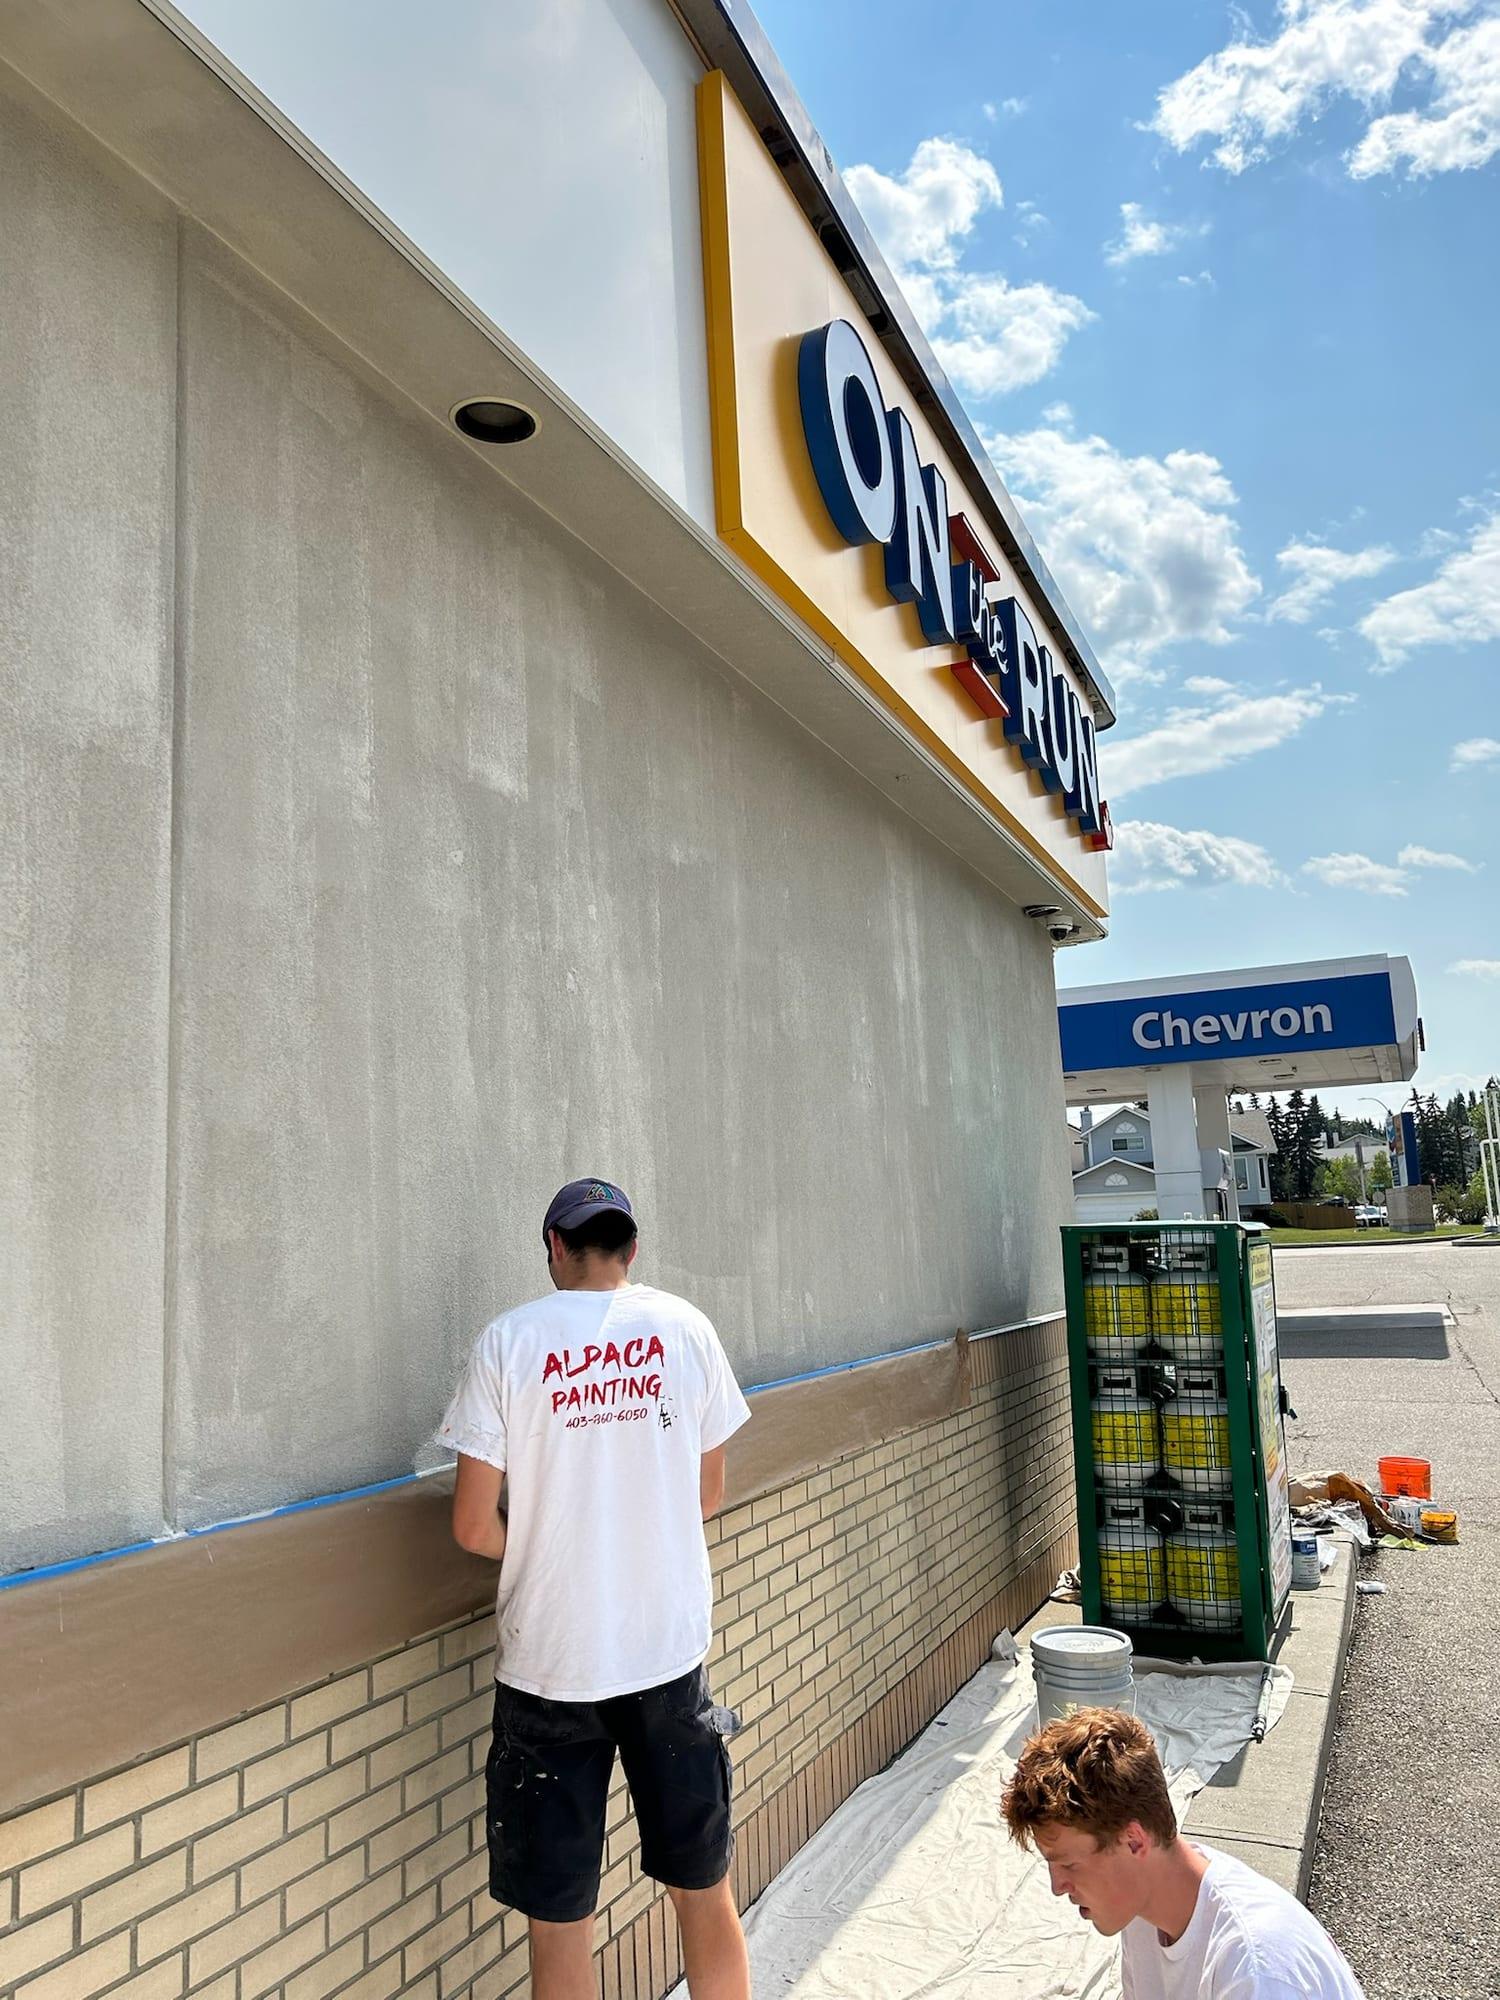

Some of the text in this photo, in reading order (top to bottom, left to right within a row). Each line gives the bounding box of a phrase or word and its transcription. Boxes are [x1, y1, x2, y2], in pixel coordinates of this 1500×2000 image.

[799, 319, 1101, 836] ON the RUN
[1131, 1003, 1334, 1050] Chevron
[542, 1335, 665, 1384] ALPACA
[552, 1374, 663, 1414] PAINTING
